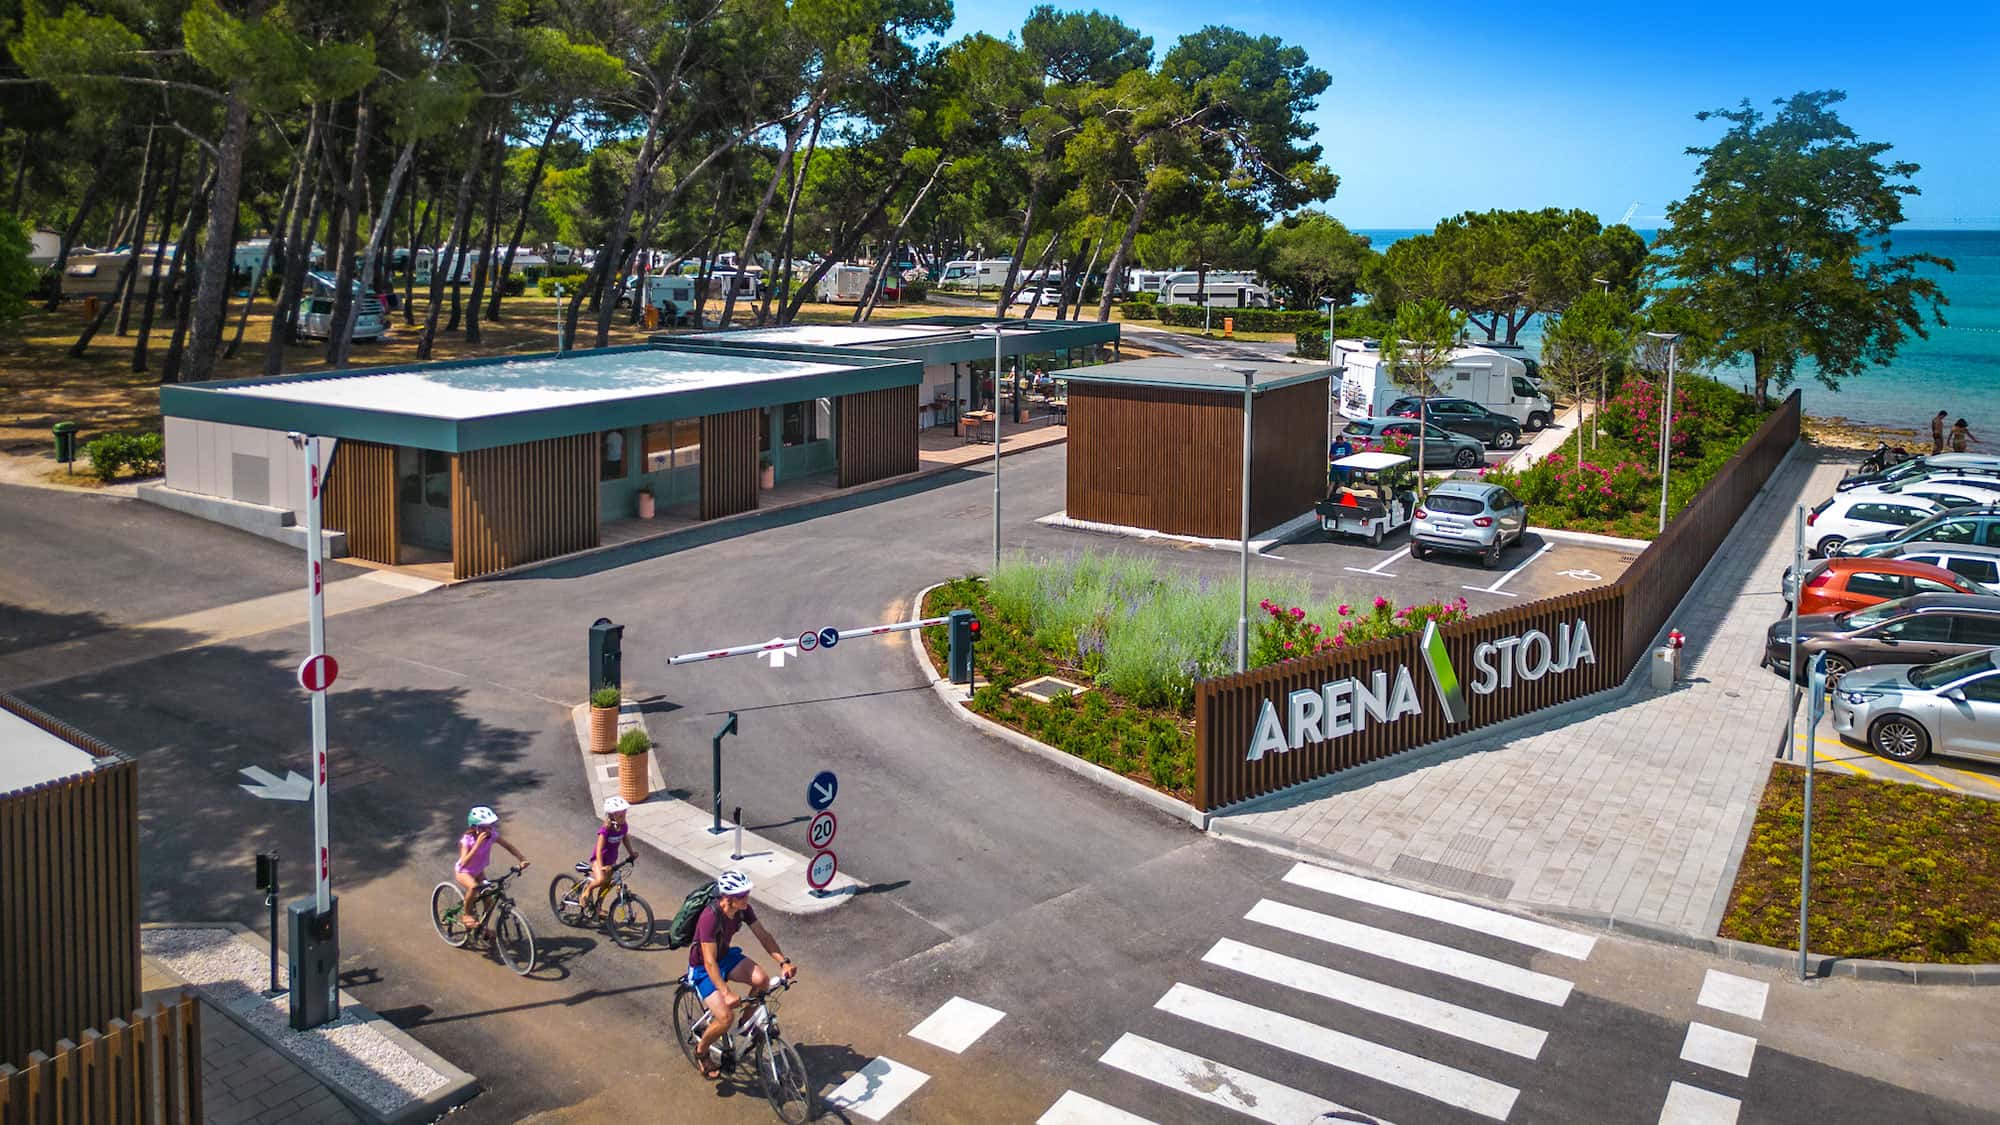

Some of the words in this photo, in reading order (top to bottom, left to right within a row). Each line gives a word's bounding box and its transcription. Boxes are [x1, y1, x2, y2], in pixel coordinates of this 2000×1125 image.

[1246, 663, 1423, 761] ARENA
[1470, 618, 1596, 694] STOJA
[814, 820, 831, 841] 20
